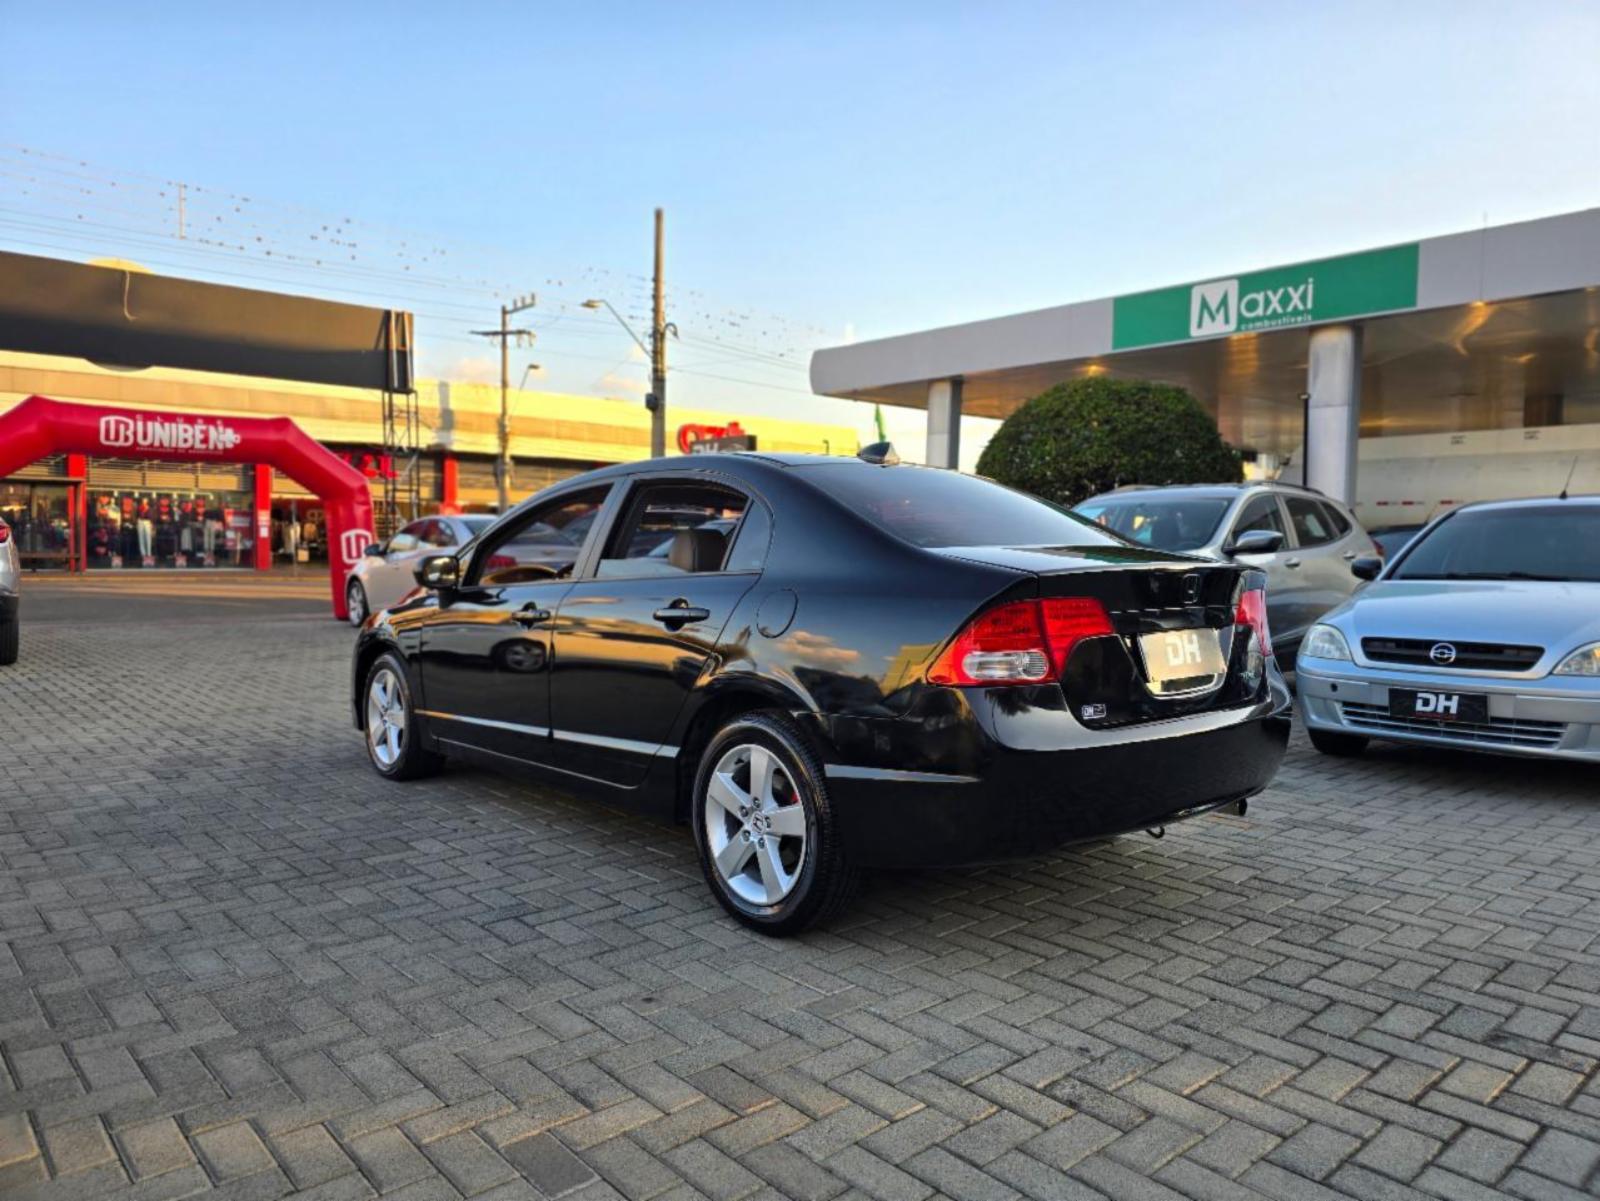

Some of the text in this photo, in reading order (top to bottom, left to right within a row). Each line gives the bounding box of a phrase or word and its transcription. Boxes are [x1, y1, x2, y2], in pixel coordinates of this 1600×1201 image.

[1197, 277, 1314, 330] Maxxi
[1165, 633, 1201, 666] DH
[1415, 692, 1459, 714] DH
